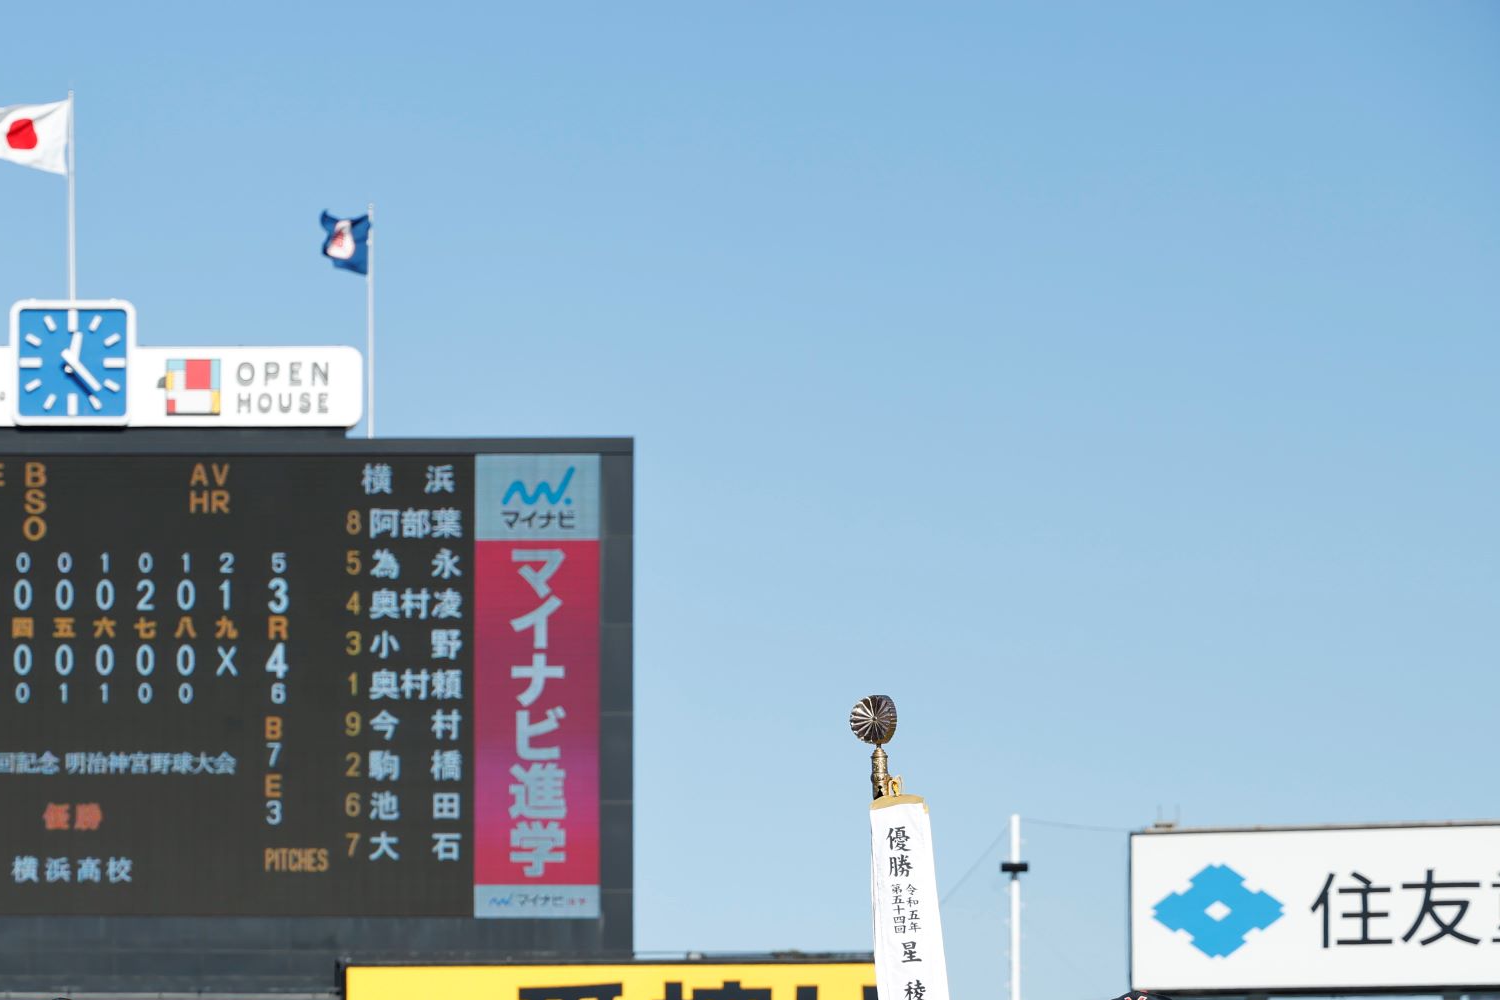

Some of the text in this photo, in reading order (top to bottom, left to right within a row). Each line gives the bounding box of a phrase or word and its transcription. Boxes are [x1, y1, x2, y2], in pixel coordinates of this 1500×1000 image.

[236, 361, 330, 386] OPEN
[236, 393, 330, 414] HOUSE
[24, 462, 47, 488] B
[24, 488, 47, 515] S
[189, 489, 230, 513] HR
[22, 515, 47, 541] O
[345, 509, 362, 535] 8
[501, 509, 575, 530] マイナビ
[15, 551, 31, 574] 0
[57, 551, 73, 574] 0
[100, 552, 110, 573] 1
[138, 551, 154, 574] 0
[181, 552, 191, 573] 1
[219, 552, 235, 574] 2
[271, 552, 287, 574] 5
[346, 549, 362, 576] 5
[13, 578, 33, 611] 0
[55, 578, 75, 611] 0
[95, 578, 115, 611] 0
[136, 579, 156, 611] 2
[176, 579, 196, 611] 0
[219, 579, 231, 611] 1
[267, 577, 289, 614] 3
[345, 591, 361, 615] 4
[11, 617, 34, 638] 四
[52, 617, 76, 638] 五
[93, 616, 116, 638] 六
[133, 617, 156, 639] 七
[174, 615, 197, 639] 八
[215, 615, 239, 639] 九
[268, 615, 288, 640] R
[345, 630, 362, 656] 3
[13, 643, 33, 676] 0
[54, 643, 74, 676] 0
[95, 644, 115, 676] 0
[136, 643, 155, 676] 0
[176, 644, 196, 676] 0
[265, 642, 289, 679] 4
[15, 682, 31, 704] 0
[59, 682, 69, 704] 1
[99, 682, 109, 704] 1
[137, 682, 153, 705] 0
[178, 682, 194, 705] 0
[270, 682, 287, 705] 6
[348, 672, 358, 695] 1
[345, 711, 361, 737] 9
[509, 550, 566, 876] マイナビ進学
[265, 716, 282, 740] B
[266, 742, 282, 767] 7
[345, 751, 361, 777] 2
[264, 773, 282, 798] E
[266, 799, 282, 825] 3
[344, 792, 361, 817] 6
[345, 832, 361, 857] 7
[886, 826, 913, 878] 優勝
[11, 855, 132, 883] 横浜高校
[264, 847, 329, 872] PITCHES
[891, 883, 906, 934] 第五十四回
[906, 883, 922, 932] 令和五年
[1310, 868, 1500, 949] 住友
